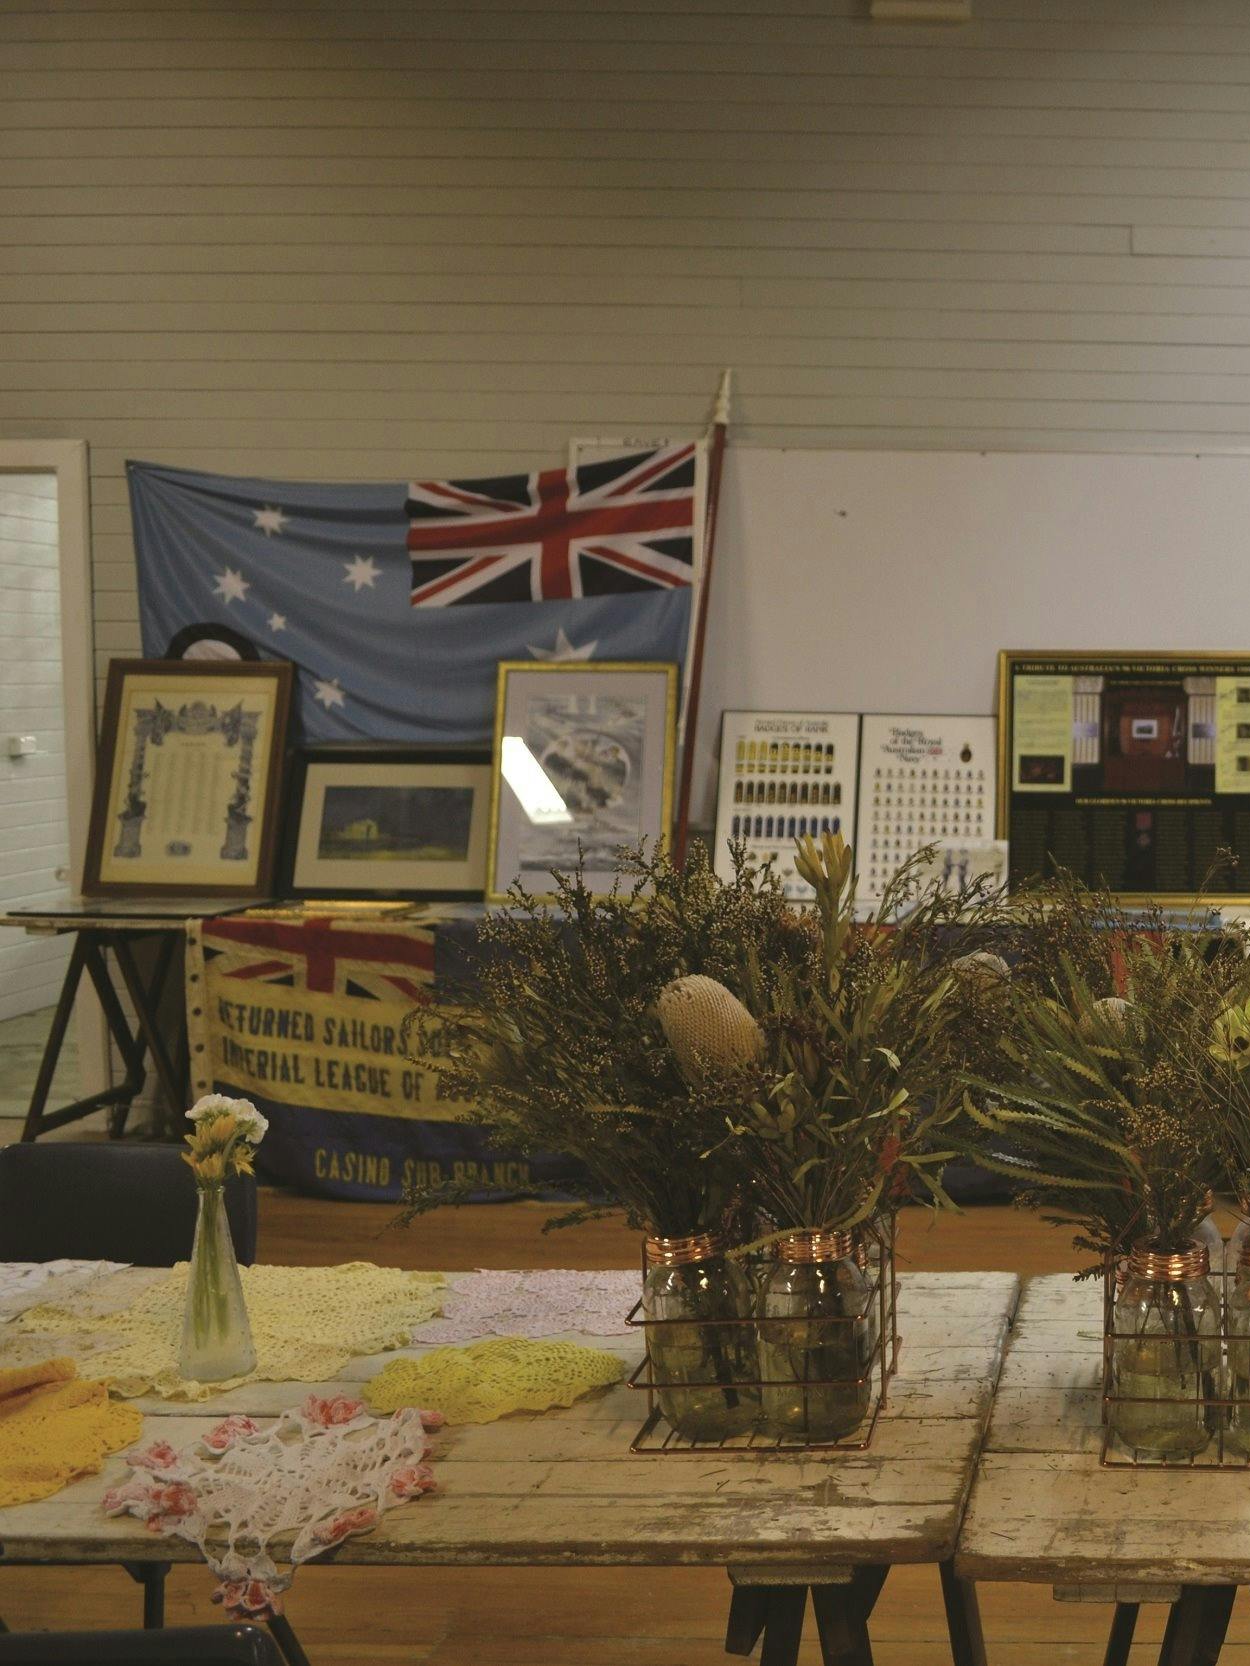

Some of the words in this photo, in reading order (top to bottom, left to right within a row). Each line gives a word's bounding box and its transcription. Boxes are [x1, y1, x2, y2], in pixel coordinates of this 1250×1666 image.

[314, 1058, 391, 1098] LEAGUE
[402, 1070, 424, 1101] OF
[314, 1149, 391, 1186] CASINO
